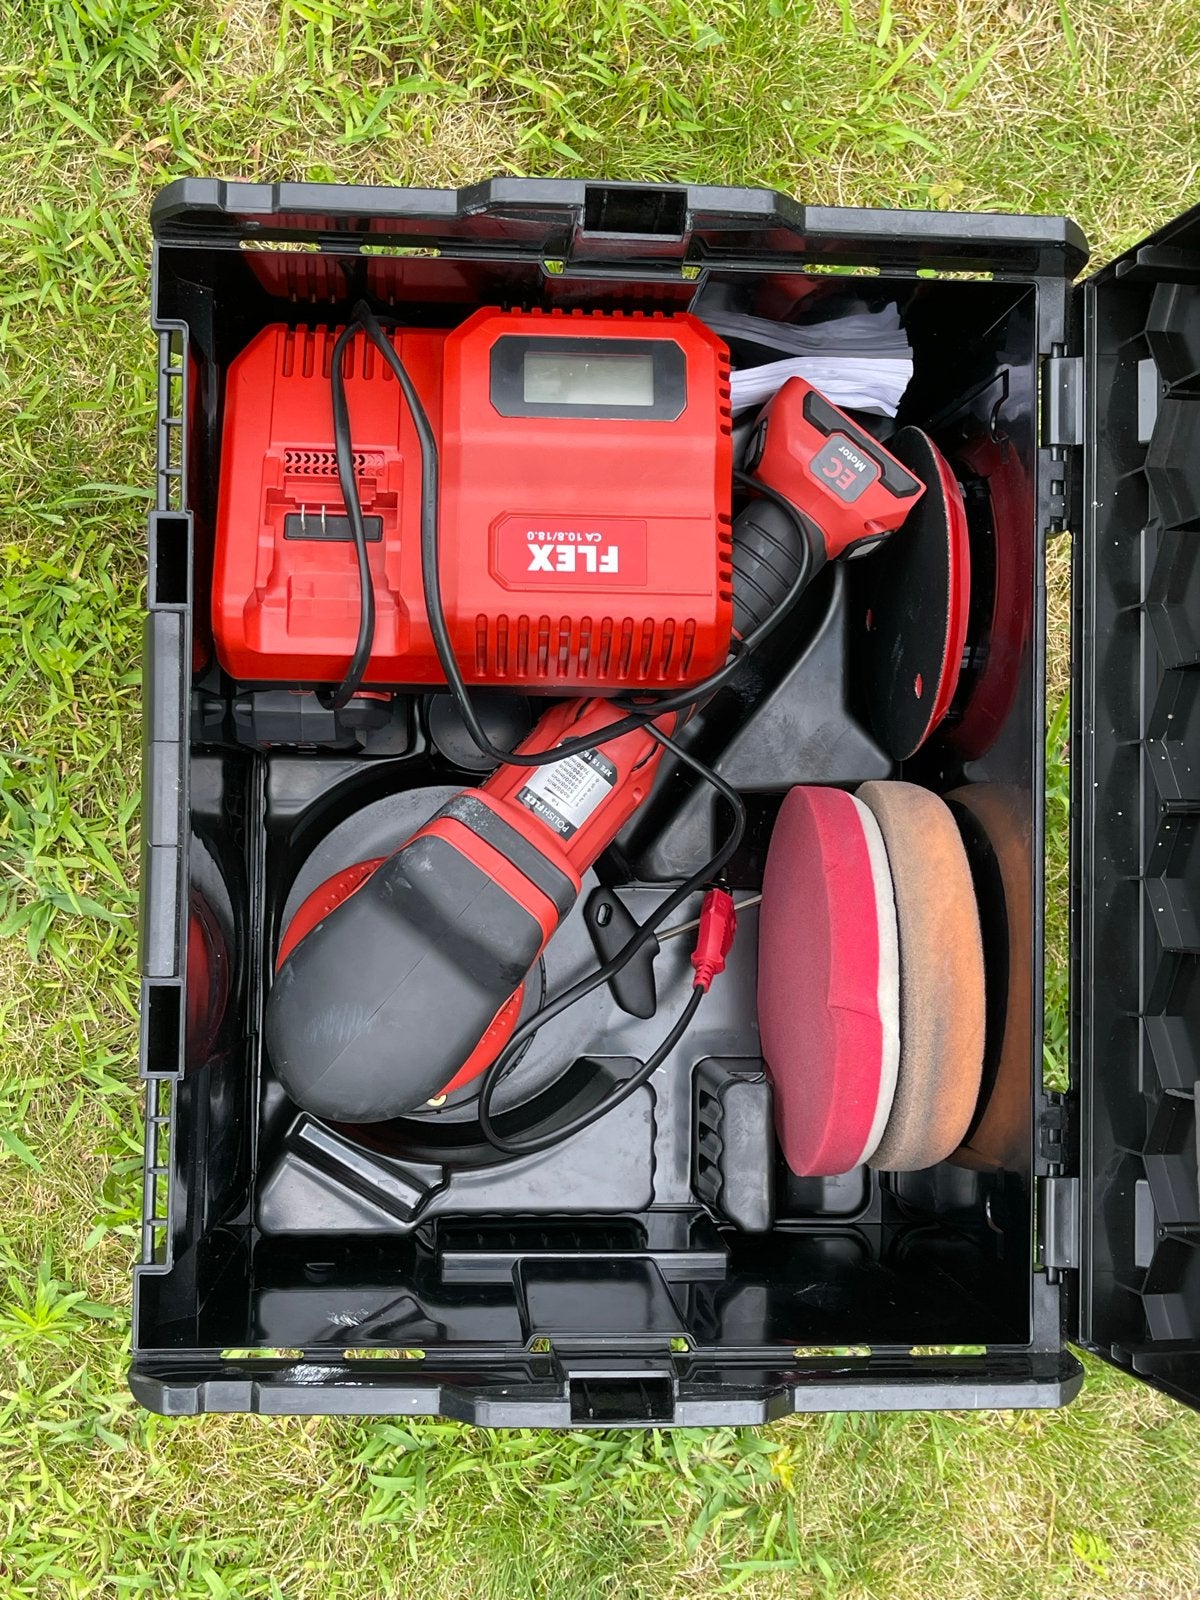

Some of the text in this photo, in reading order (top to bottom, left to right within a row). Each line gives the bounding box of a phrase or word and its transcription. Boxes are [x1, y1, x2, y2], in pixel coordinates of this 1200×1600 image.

[838, 446, 867, 473] Motor
[822, 457, 857, 490] EC
[527, 531, 602, 542] CA 10.8/18.0
[527, 544, 619, 573] FLEX
[591, 758, 600, 767] 15
[600, 765, 613, 777] XFE
